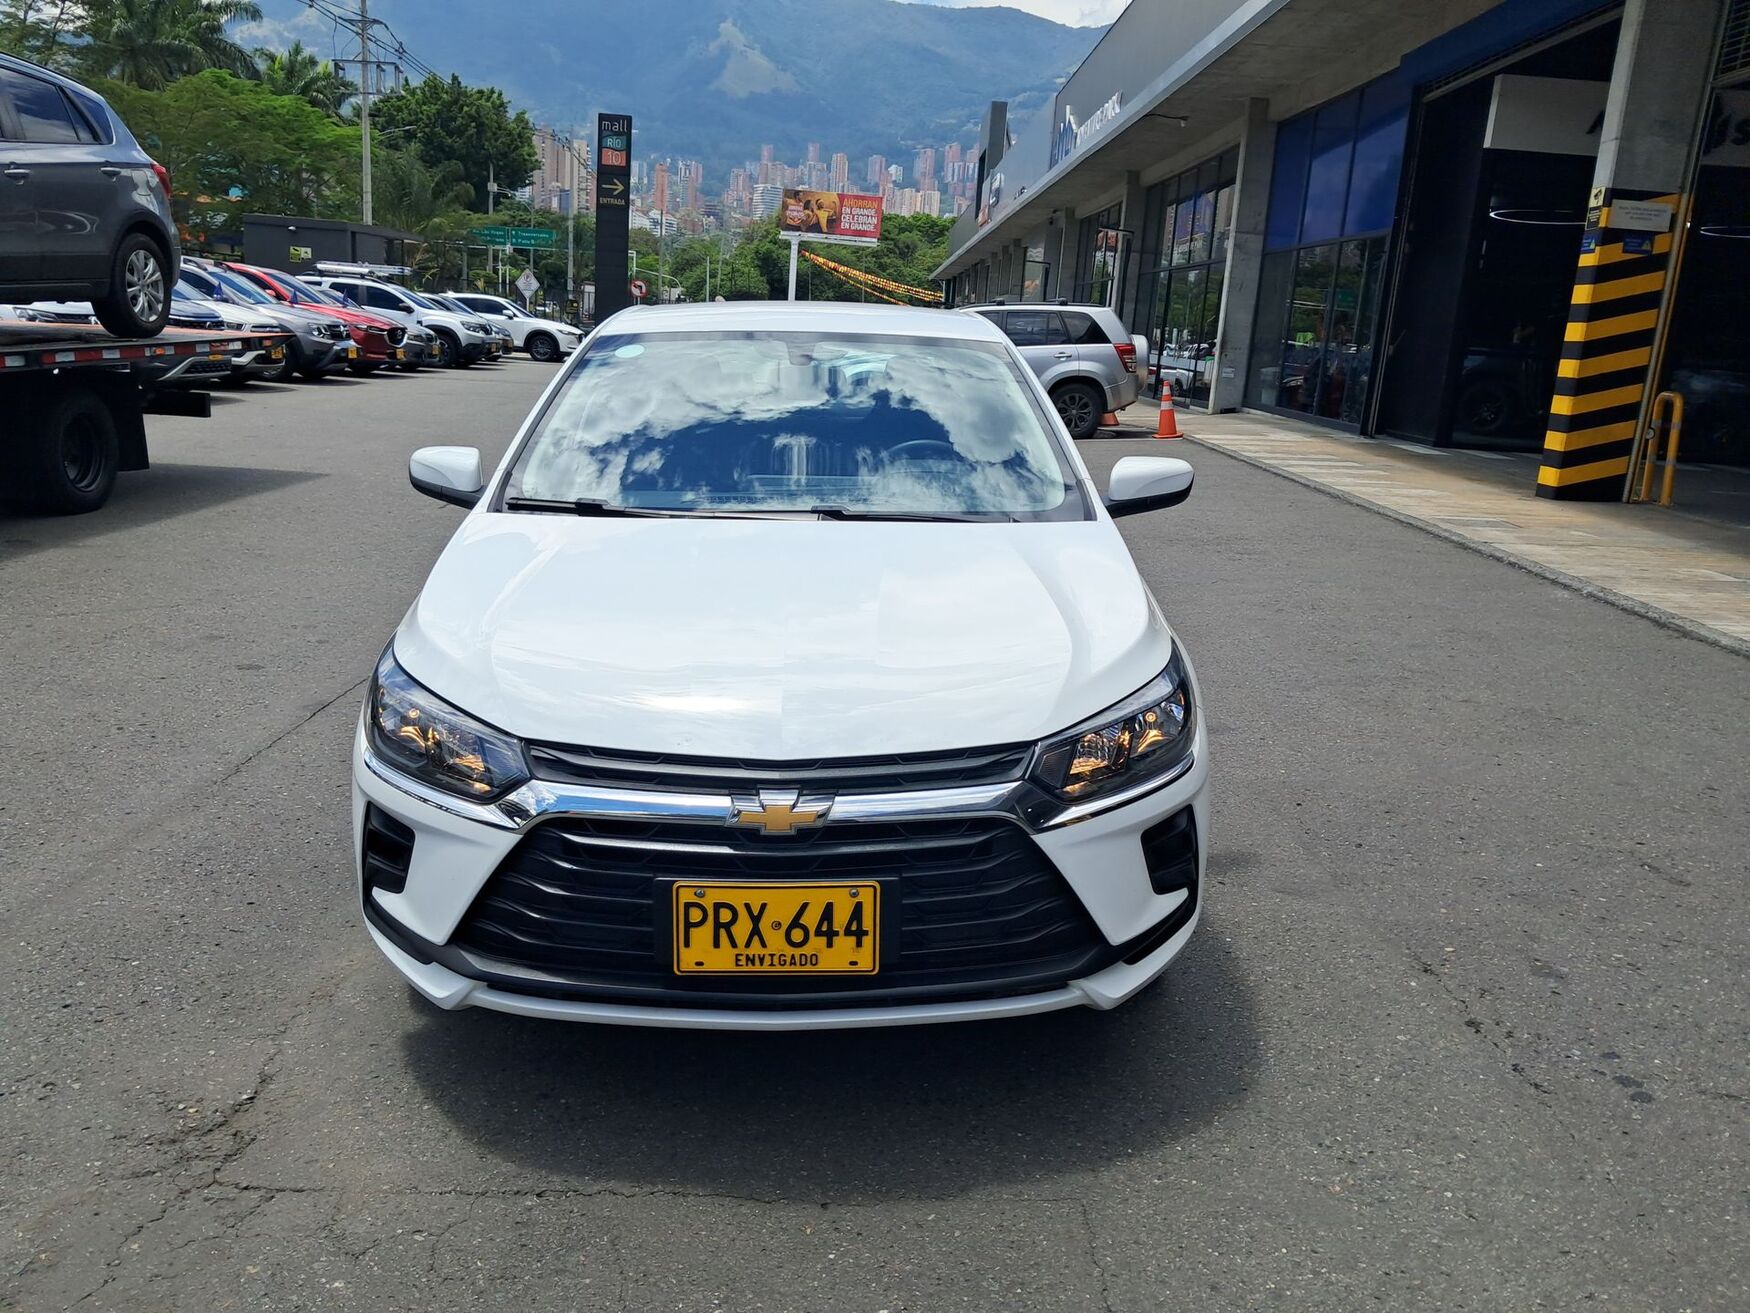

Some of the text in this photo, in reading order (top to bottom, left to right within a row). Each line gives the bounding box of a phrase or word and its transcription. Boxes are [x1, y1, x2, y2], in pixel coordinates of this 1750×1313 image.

[601, 119, 628, 132] mall
[607, 138, 622, 148] RIO
[607, 151, 621, 166] 10
[599, 197, 626, 205] ENTRADA
[843, 198, 878, 209] AHORRAN
[841, 206, 850, 214] EN
[841, 214, 878, 225] CELEBRAN
[840, 221, 850, 230] EN
[683, 900, 869, 949] PRX 644
[734, 953, 819, 967] ENVIGADO
